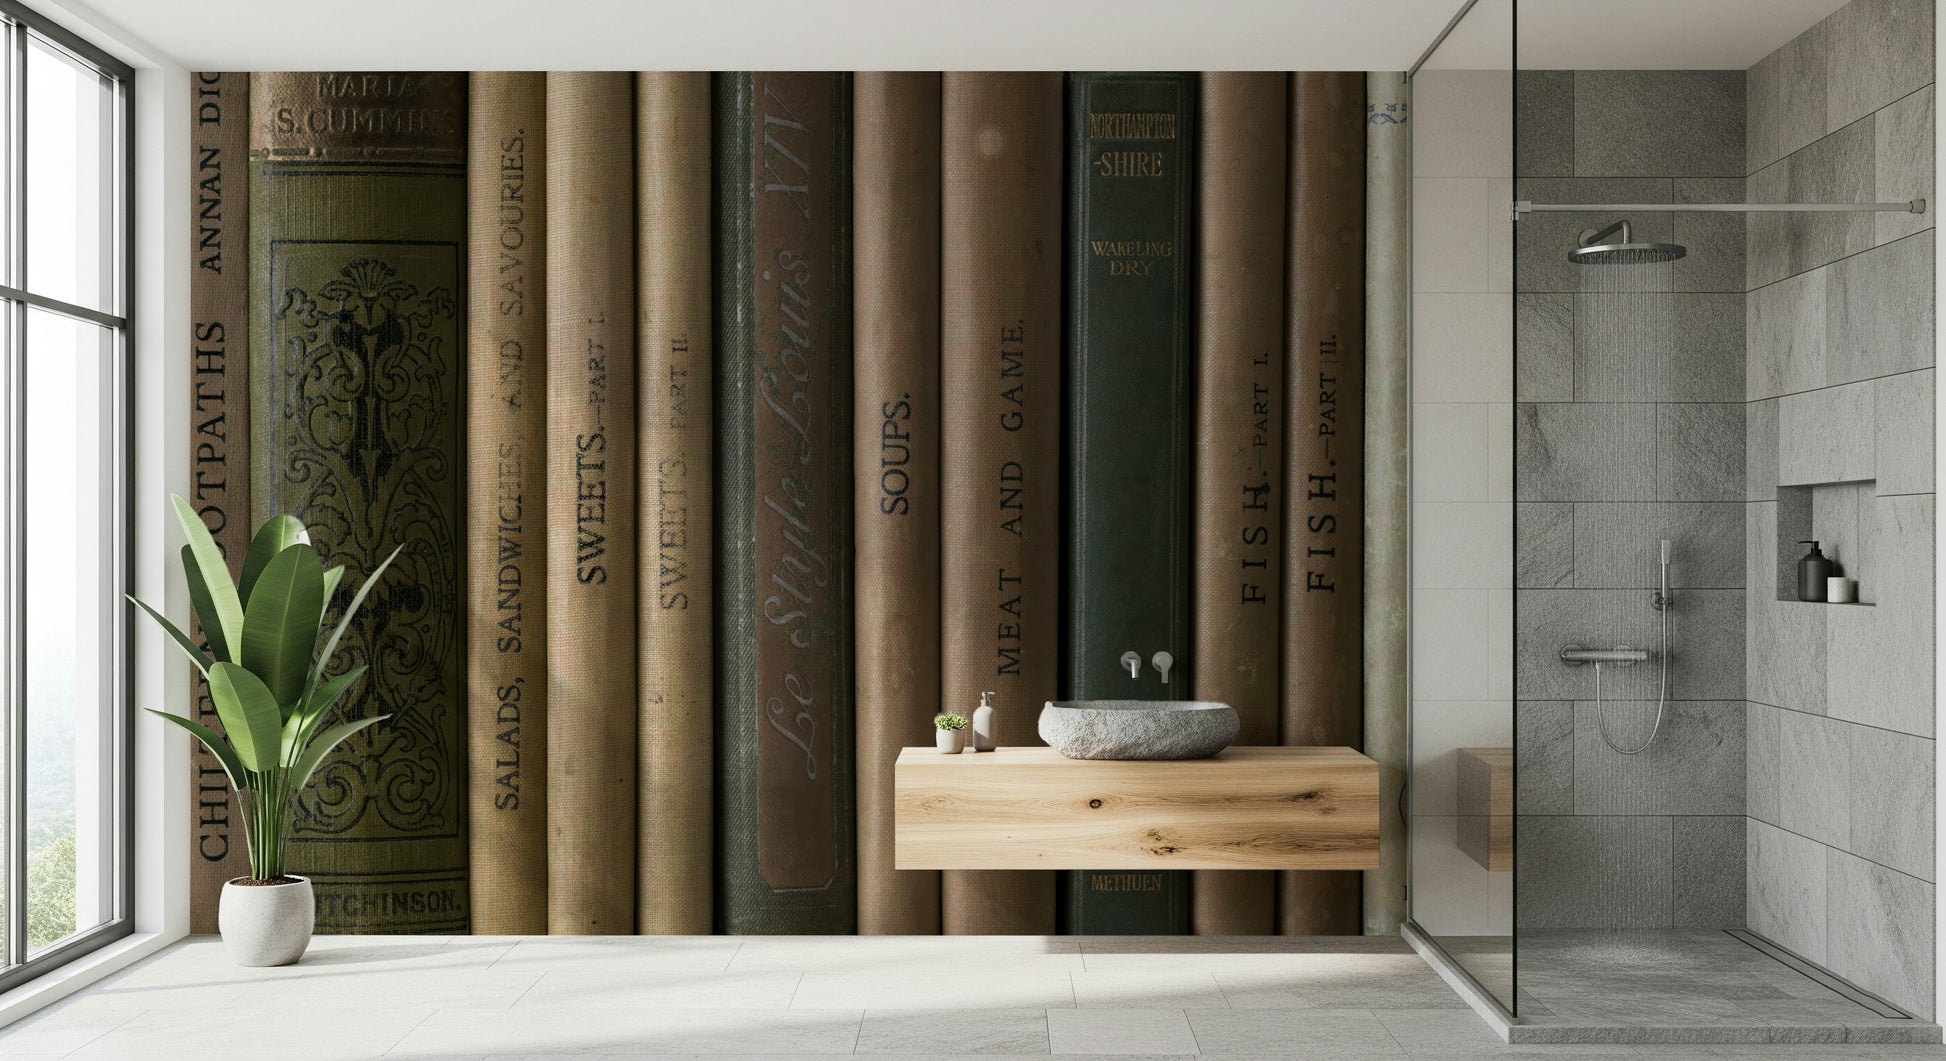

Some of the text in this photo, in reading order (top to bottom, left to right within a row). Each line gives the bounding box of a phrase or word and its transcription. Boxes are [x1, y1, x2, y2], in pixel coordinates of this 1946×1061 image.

[315, 74, 420, 99] MARIA
[1089, 112, 1176, 139] NORTHAMPTON
[1092, 151, 1163, 177] -SHIRE
[199, 146, 222, 275] ANNAN
[499, 128, 525, 316] SAVOURIES.
[1090, 240, 1173, 257] WAKELING
[1109, 259, 1153, 276] DRY
[1253, 352, 1269, 367] I.
[1318, 333, 1338, 357] II.
[499, 340, 523, 411] AND
[669, 365, 689, 430] PART
[759, 80, 829, 781] Le Style Louis XIV
[880, 391, 912, 517] SOUPS.
[997, 318, 1025, 678] MEAT AND GAME.
[494, 677, 525, 811] SALADS,
[1090, 873, 1163, 892] METHUEN
